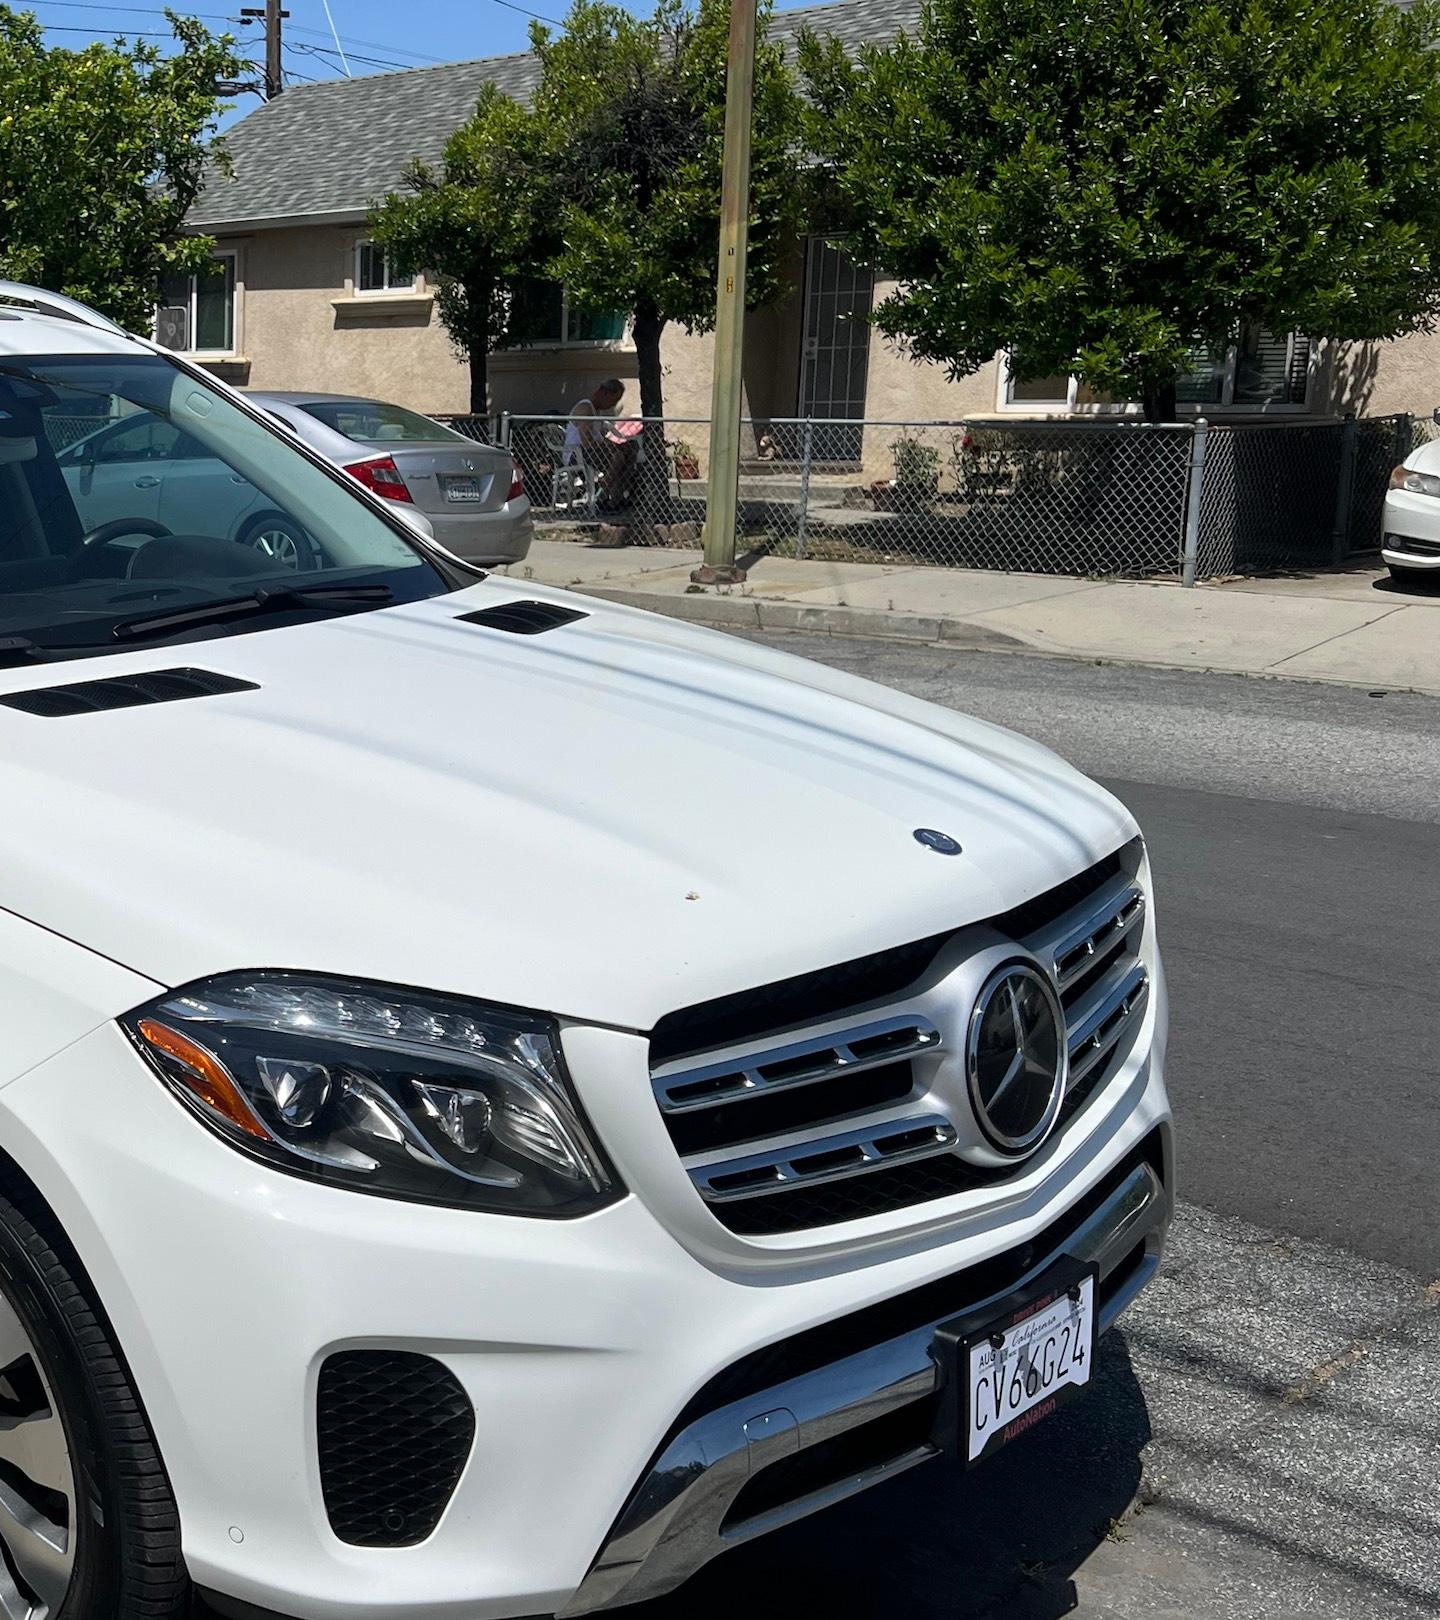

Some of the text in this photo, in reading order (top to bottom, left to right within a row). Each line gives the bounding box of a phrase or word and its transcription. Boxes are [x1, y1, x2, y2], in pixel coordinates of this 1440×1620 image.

[1011, 1315, 1057, 1347] California
[975, 1317, 1086, 1432] CV66G24
[978, 1348, 996, 1368] AUG
[1003, 1397, 1056, 1442] AutoNation
